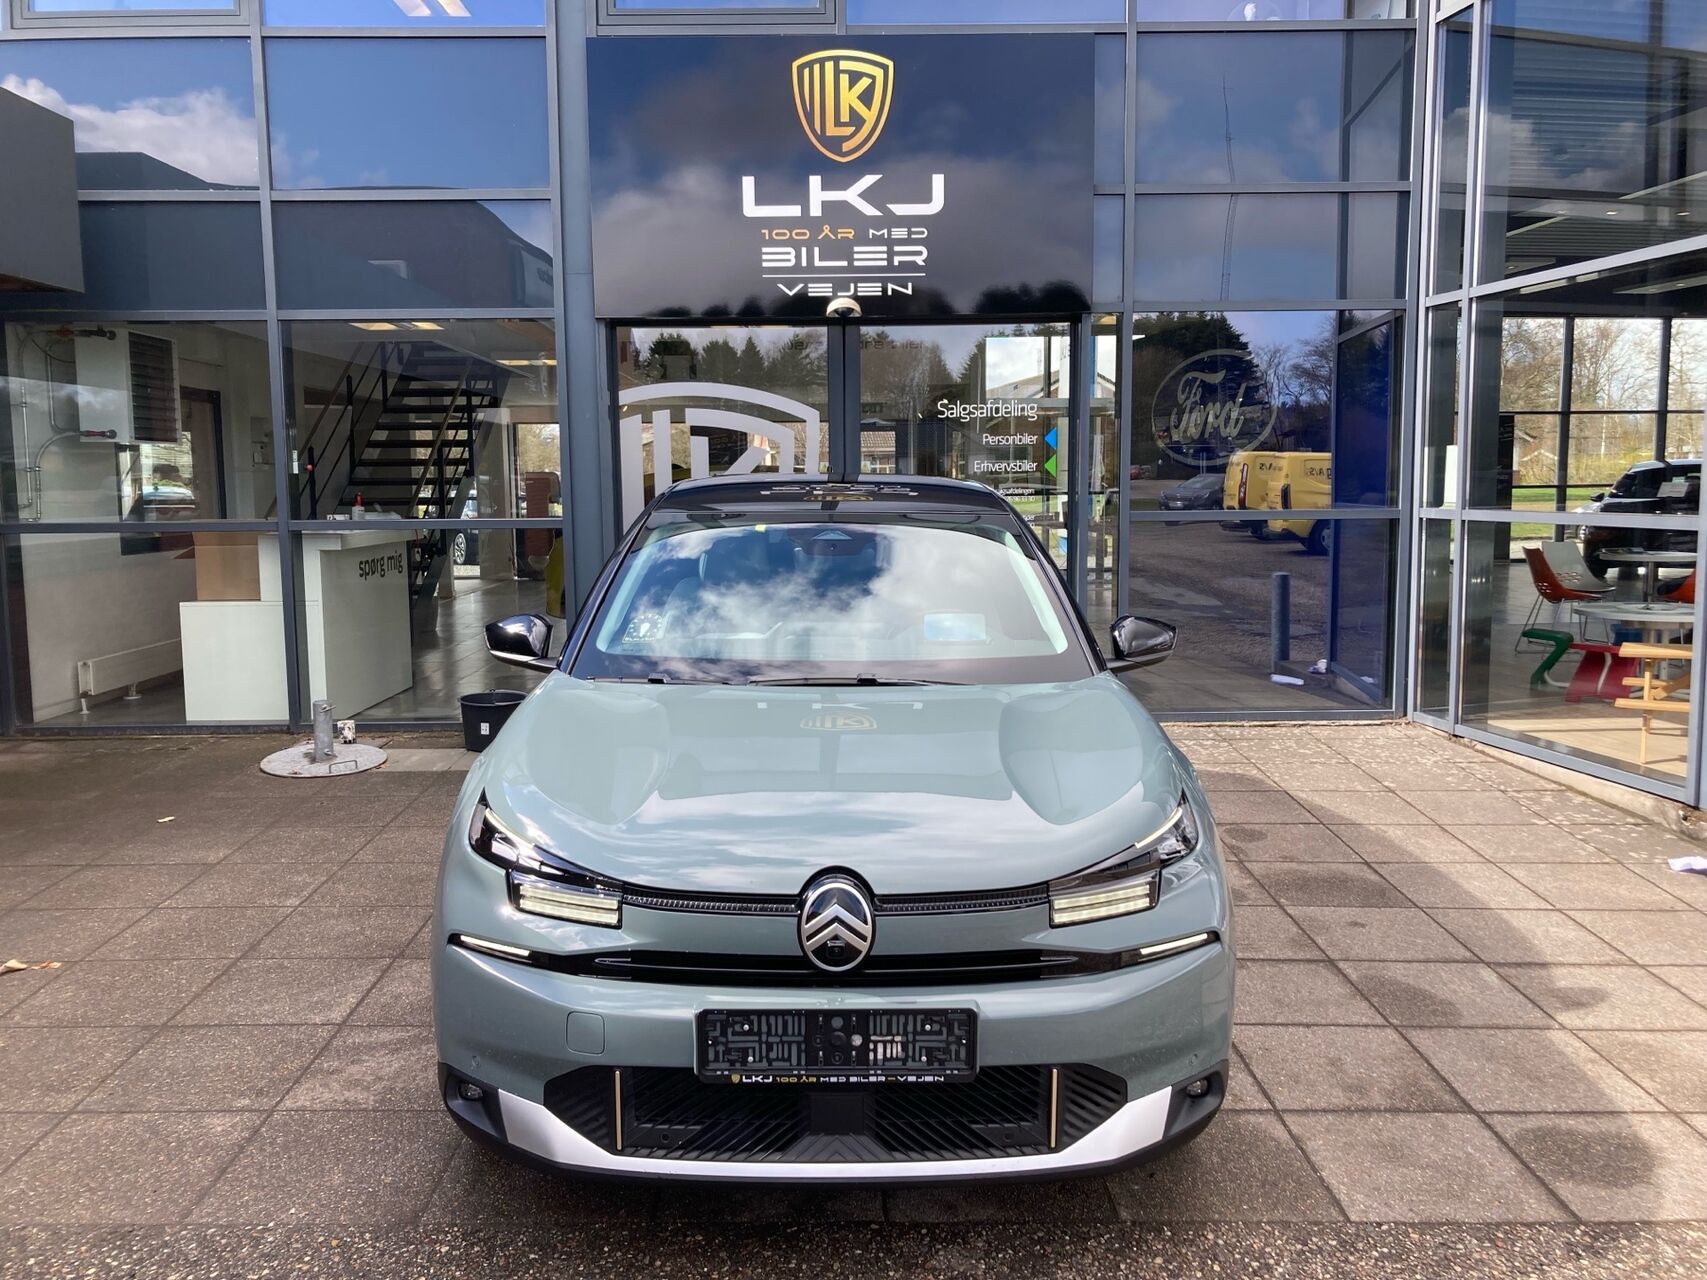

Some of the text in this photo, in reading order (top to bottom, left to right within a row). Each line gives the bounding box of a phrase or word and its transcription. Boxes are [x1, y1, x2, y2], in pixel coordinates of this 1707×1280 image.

[742, 174, 945, 217] LKJ
[761, 224, 928, 240] 100 ÅR MED
[762, 246, 928, 267] BILER
[777, 282, 912, 296] VEJEN
[937, 399, 1038, 422] Salgsafdeling
[1170, 368, 1247, 442] Ford
[982, 433, 1038, 445] Personbiler
[974, 460, 1038, 472] Erhvervsbiler
[358, 549, 403, 581] spørg mig
[742, 1075, 773, 1083] LKJ
[897, 1075, 945, 1083] VEJEN
